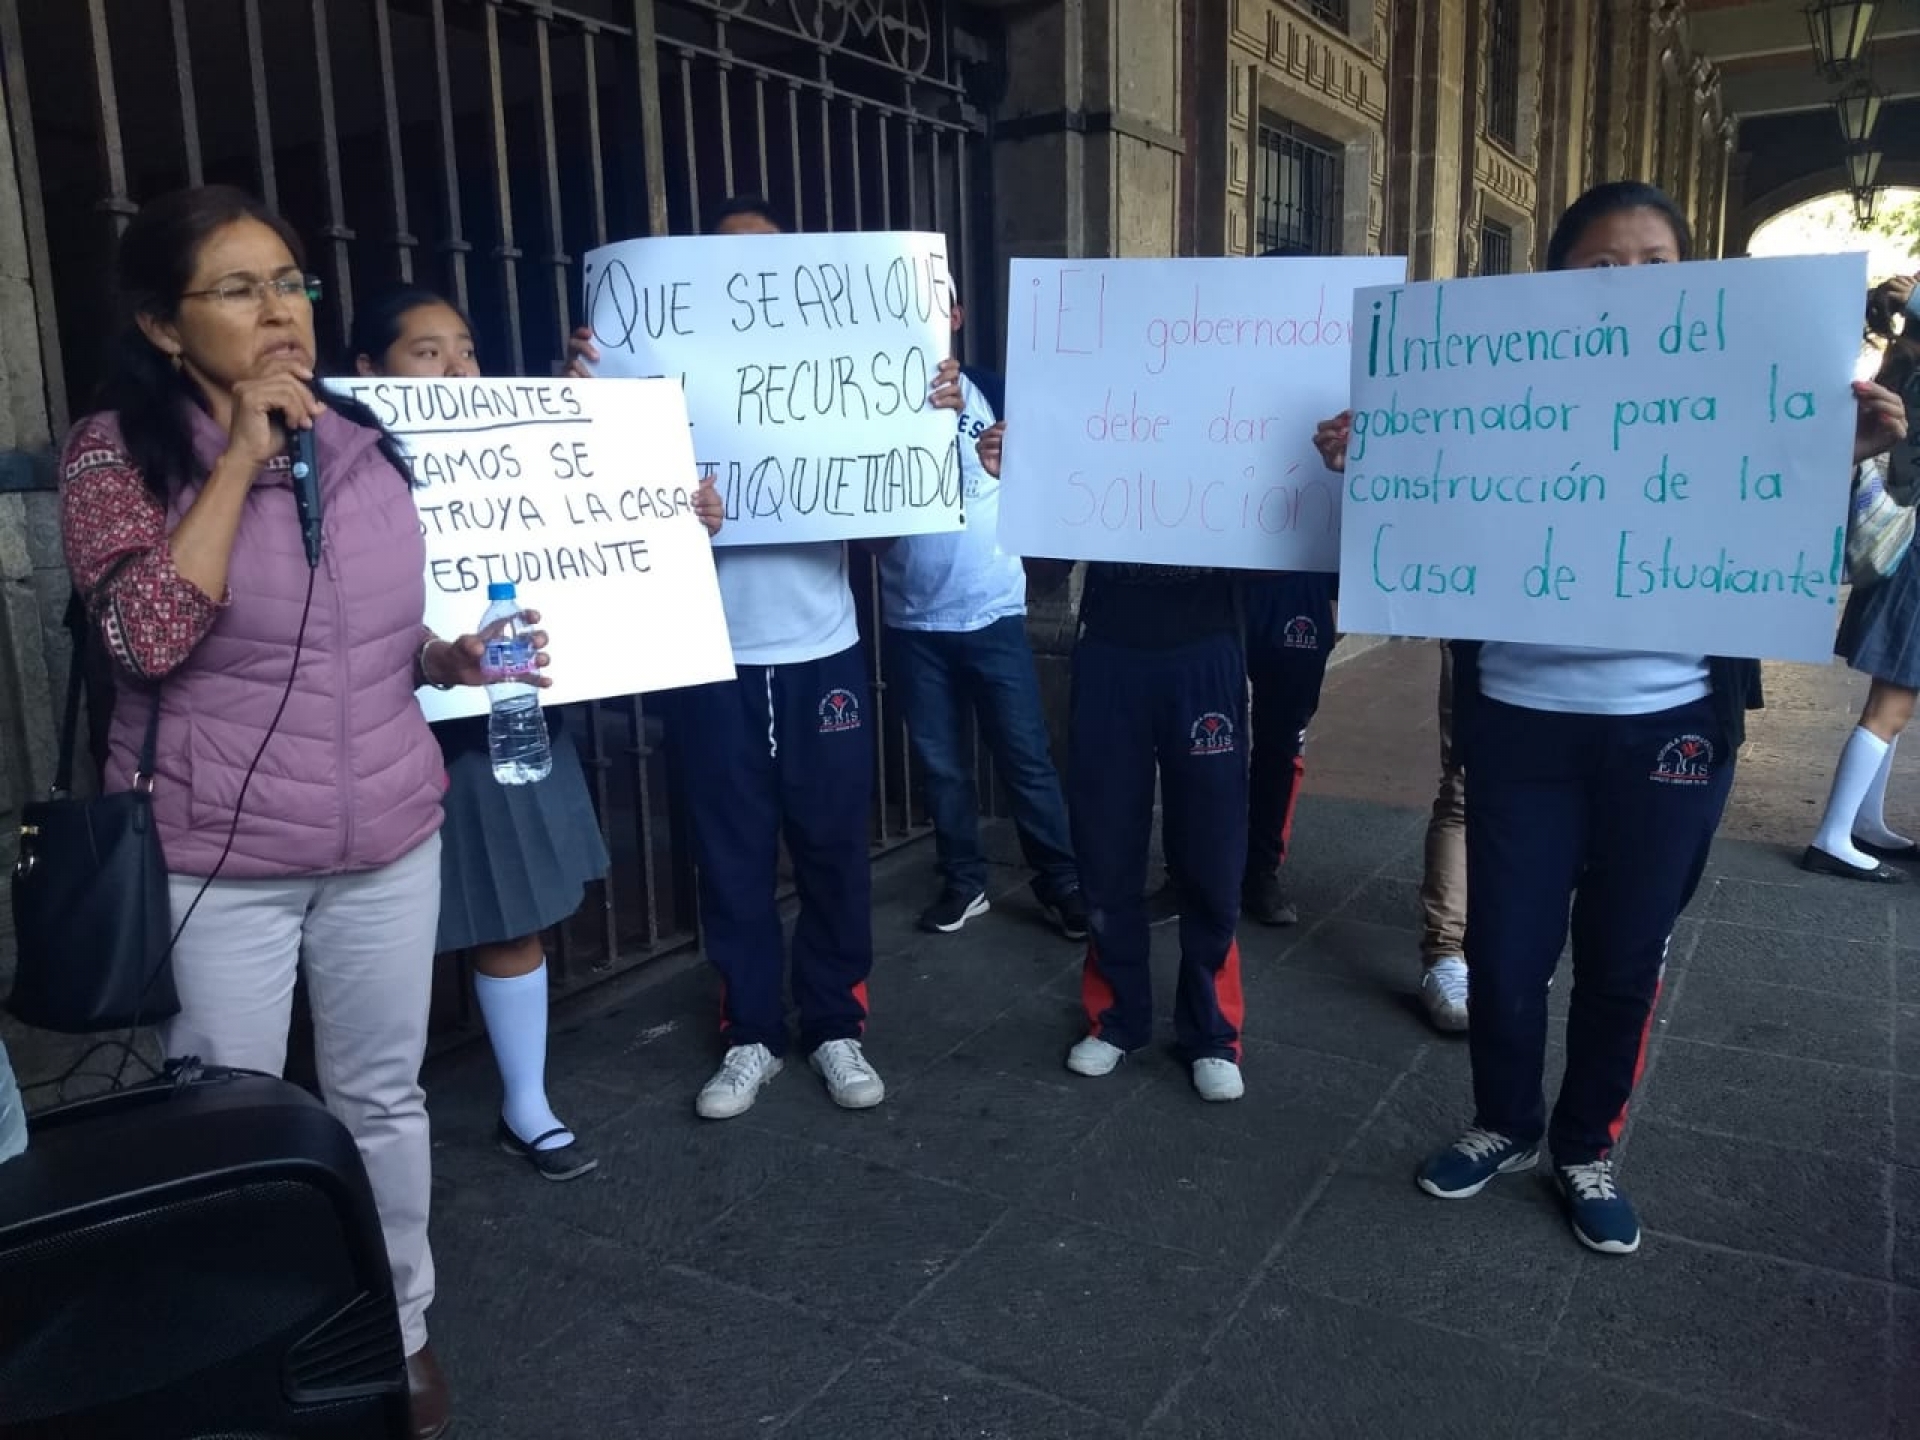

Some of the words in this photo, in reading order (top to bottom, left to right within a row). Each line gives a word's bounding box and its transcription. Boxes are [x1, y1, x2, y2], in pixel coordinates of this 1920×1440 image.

[1367, 284, 1629, 377] ¡Intervención
[1658, 287, 1725, 356] del
[737, 346, 928, 426] RECURSO
[1085, 386, 1171, 443] debe
[1207, 386, 1280, 445] dar
[1351, 386, 1580, 462] gobernador
[1612, 395, 1717, 452] para
[1768, 363, 1816, 424] la
[549, 442, 595, 480] SE
[1349, 450, 1605, 505] construcción
[1643, 453, 1690, 503] de
[1740, 455, 1783, 502] la
[565, 493, 607, 525] LA
[620, 487, 692, 521] CASA
[430, 539, 652, 593] ESTUDIANTE
[1372, 523, 1478, 597] Casa
[1523, 526, 1577, 601] de
[1615, 525, 1845, 605] Estudiante!
